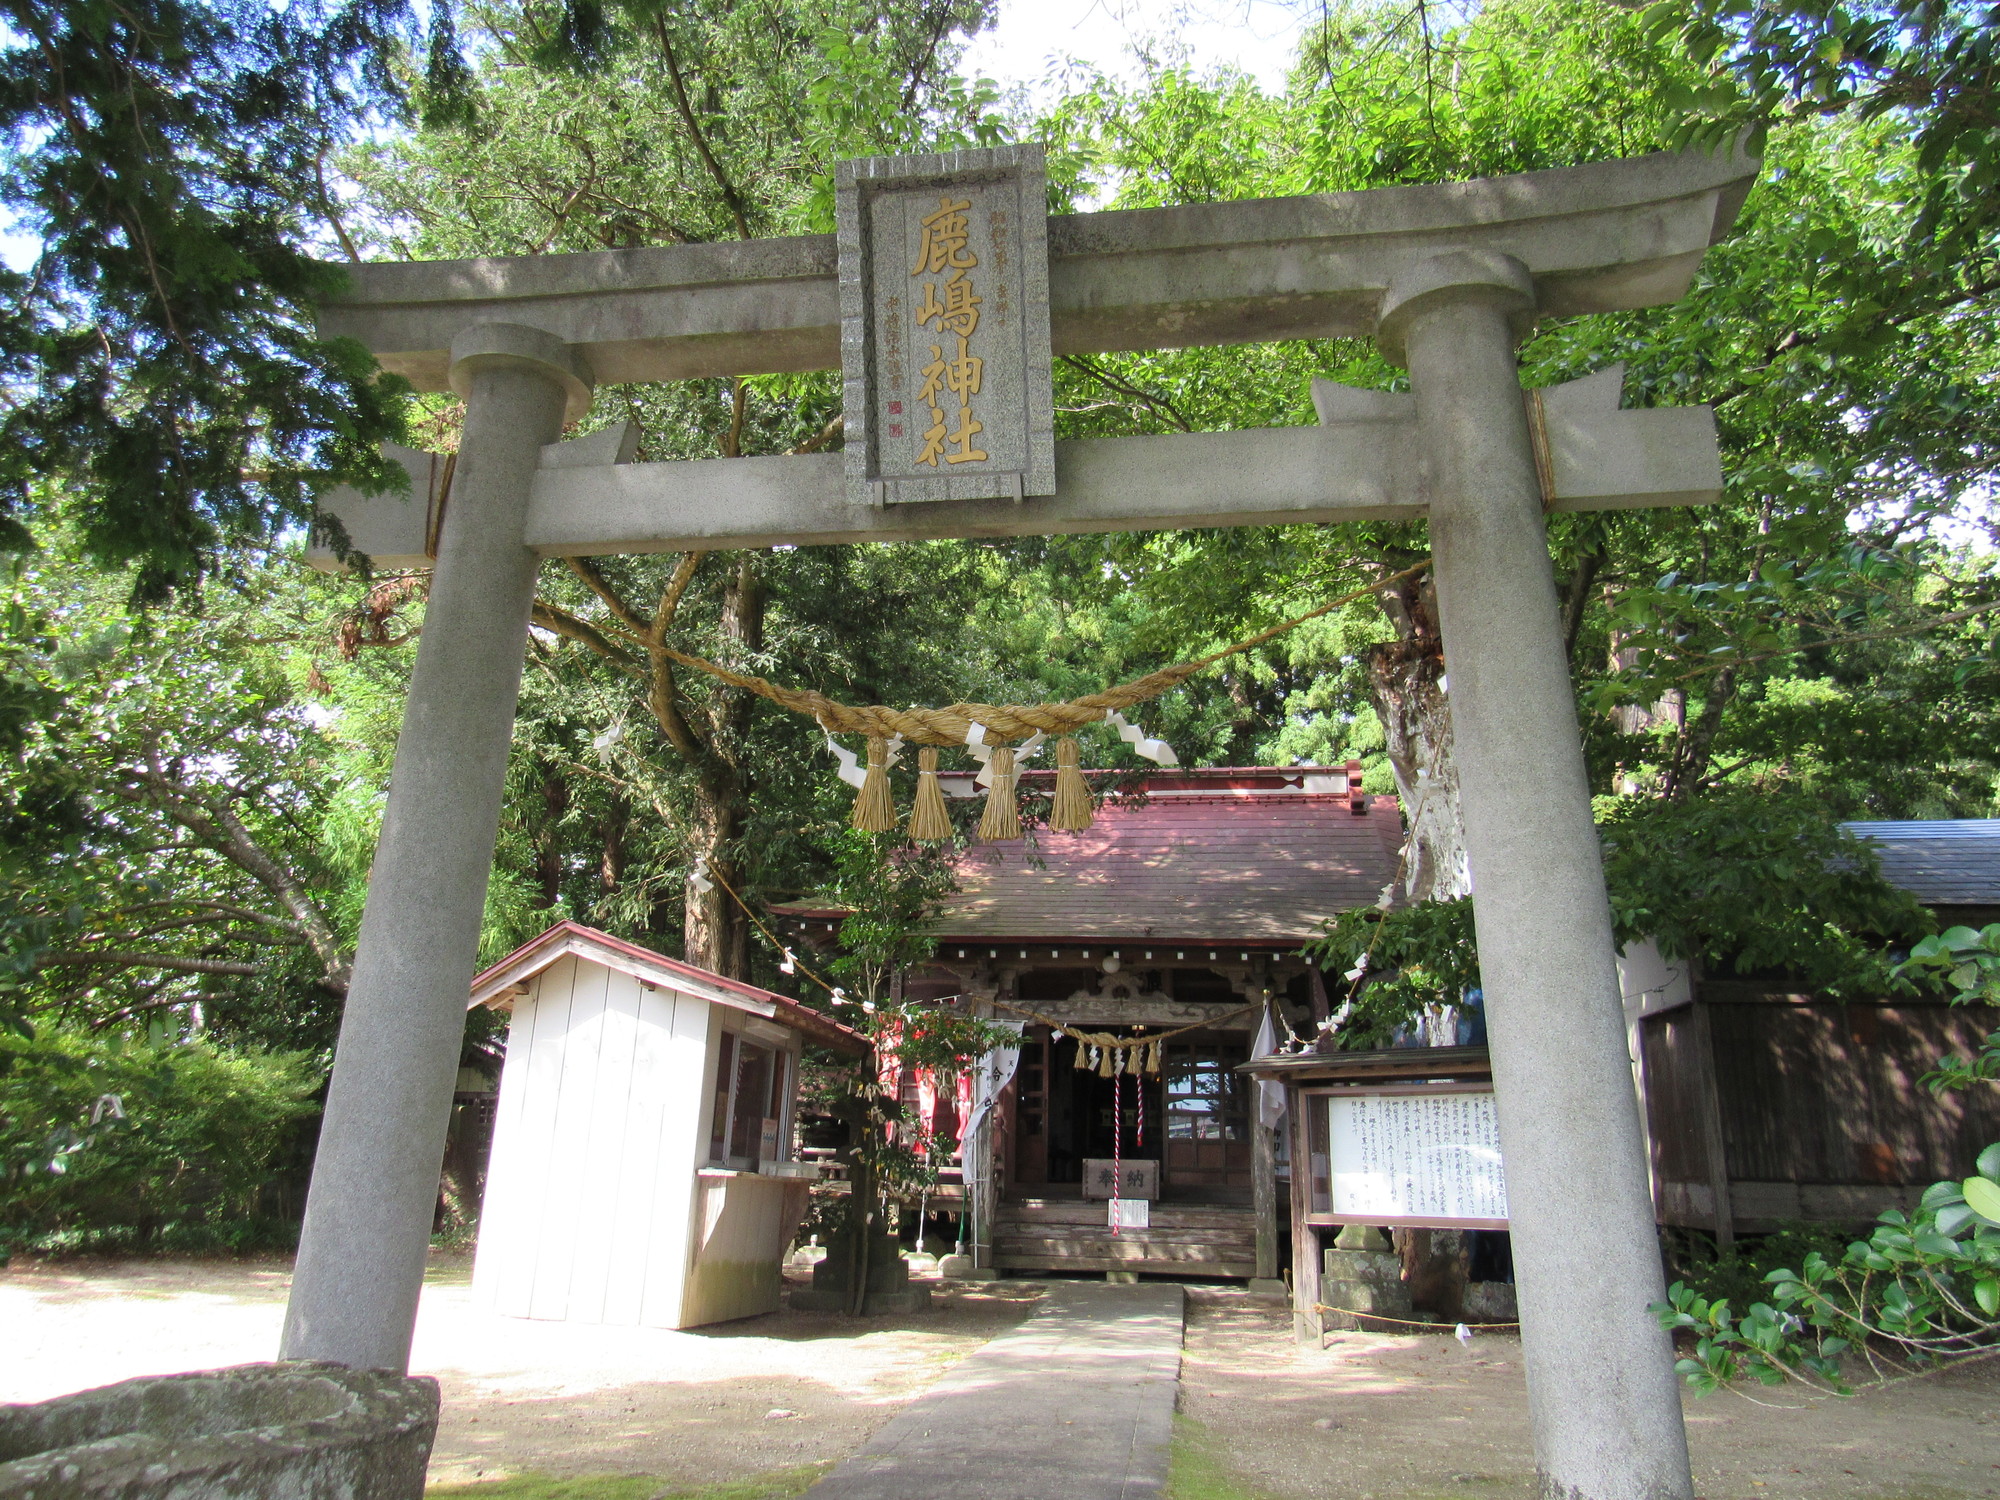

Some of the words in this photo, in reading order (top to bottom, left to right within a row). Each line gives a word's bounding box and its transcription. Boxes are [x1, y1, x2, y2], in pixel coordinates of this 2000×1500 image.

[912, 198, 989, 467] 鹿嶋神社
[1099, 1167, 1145, 1188] 奉納
